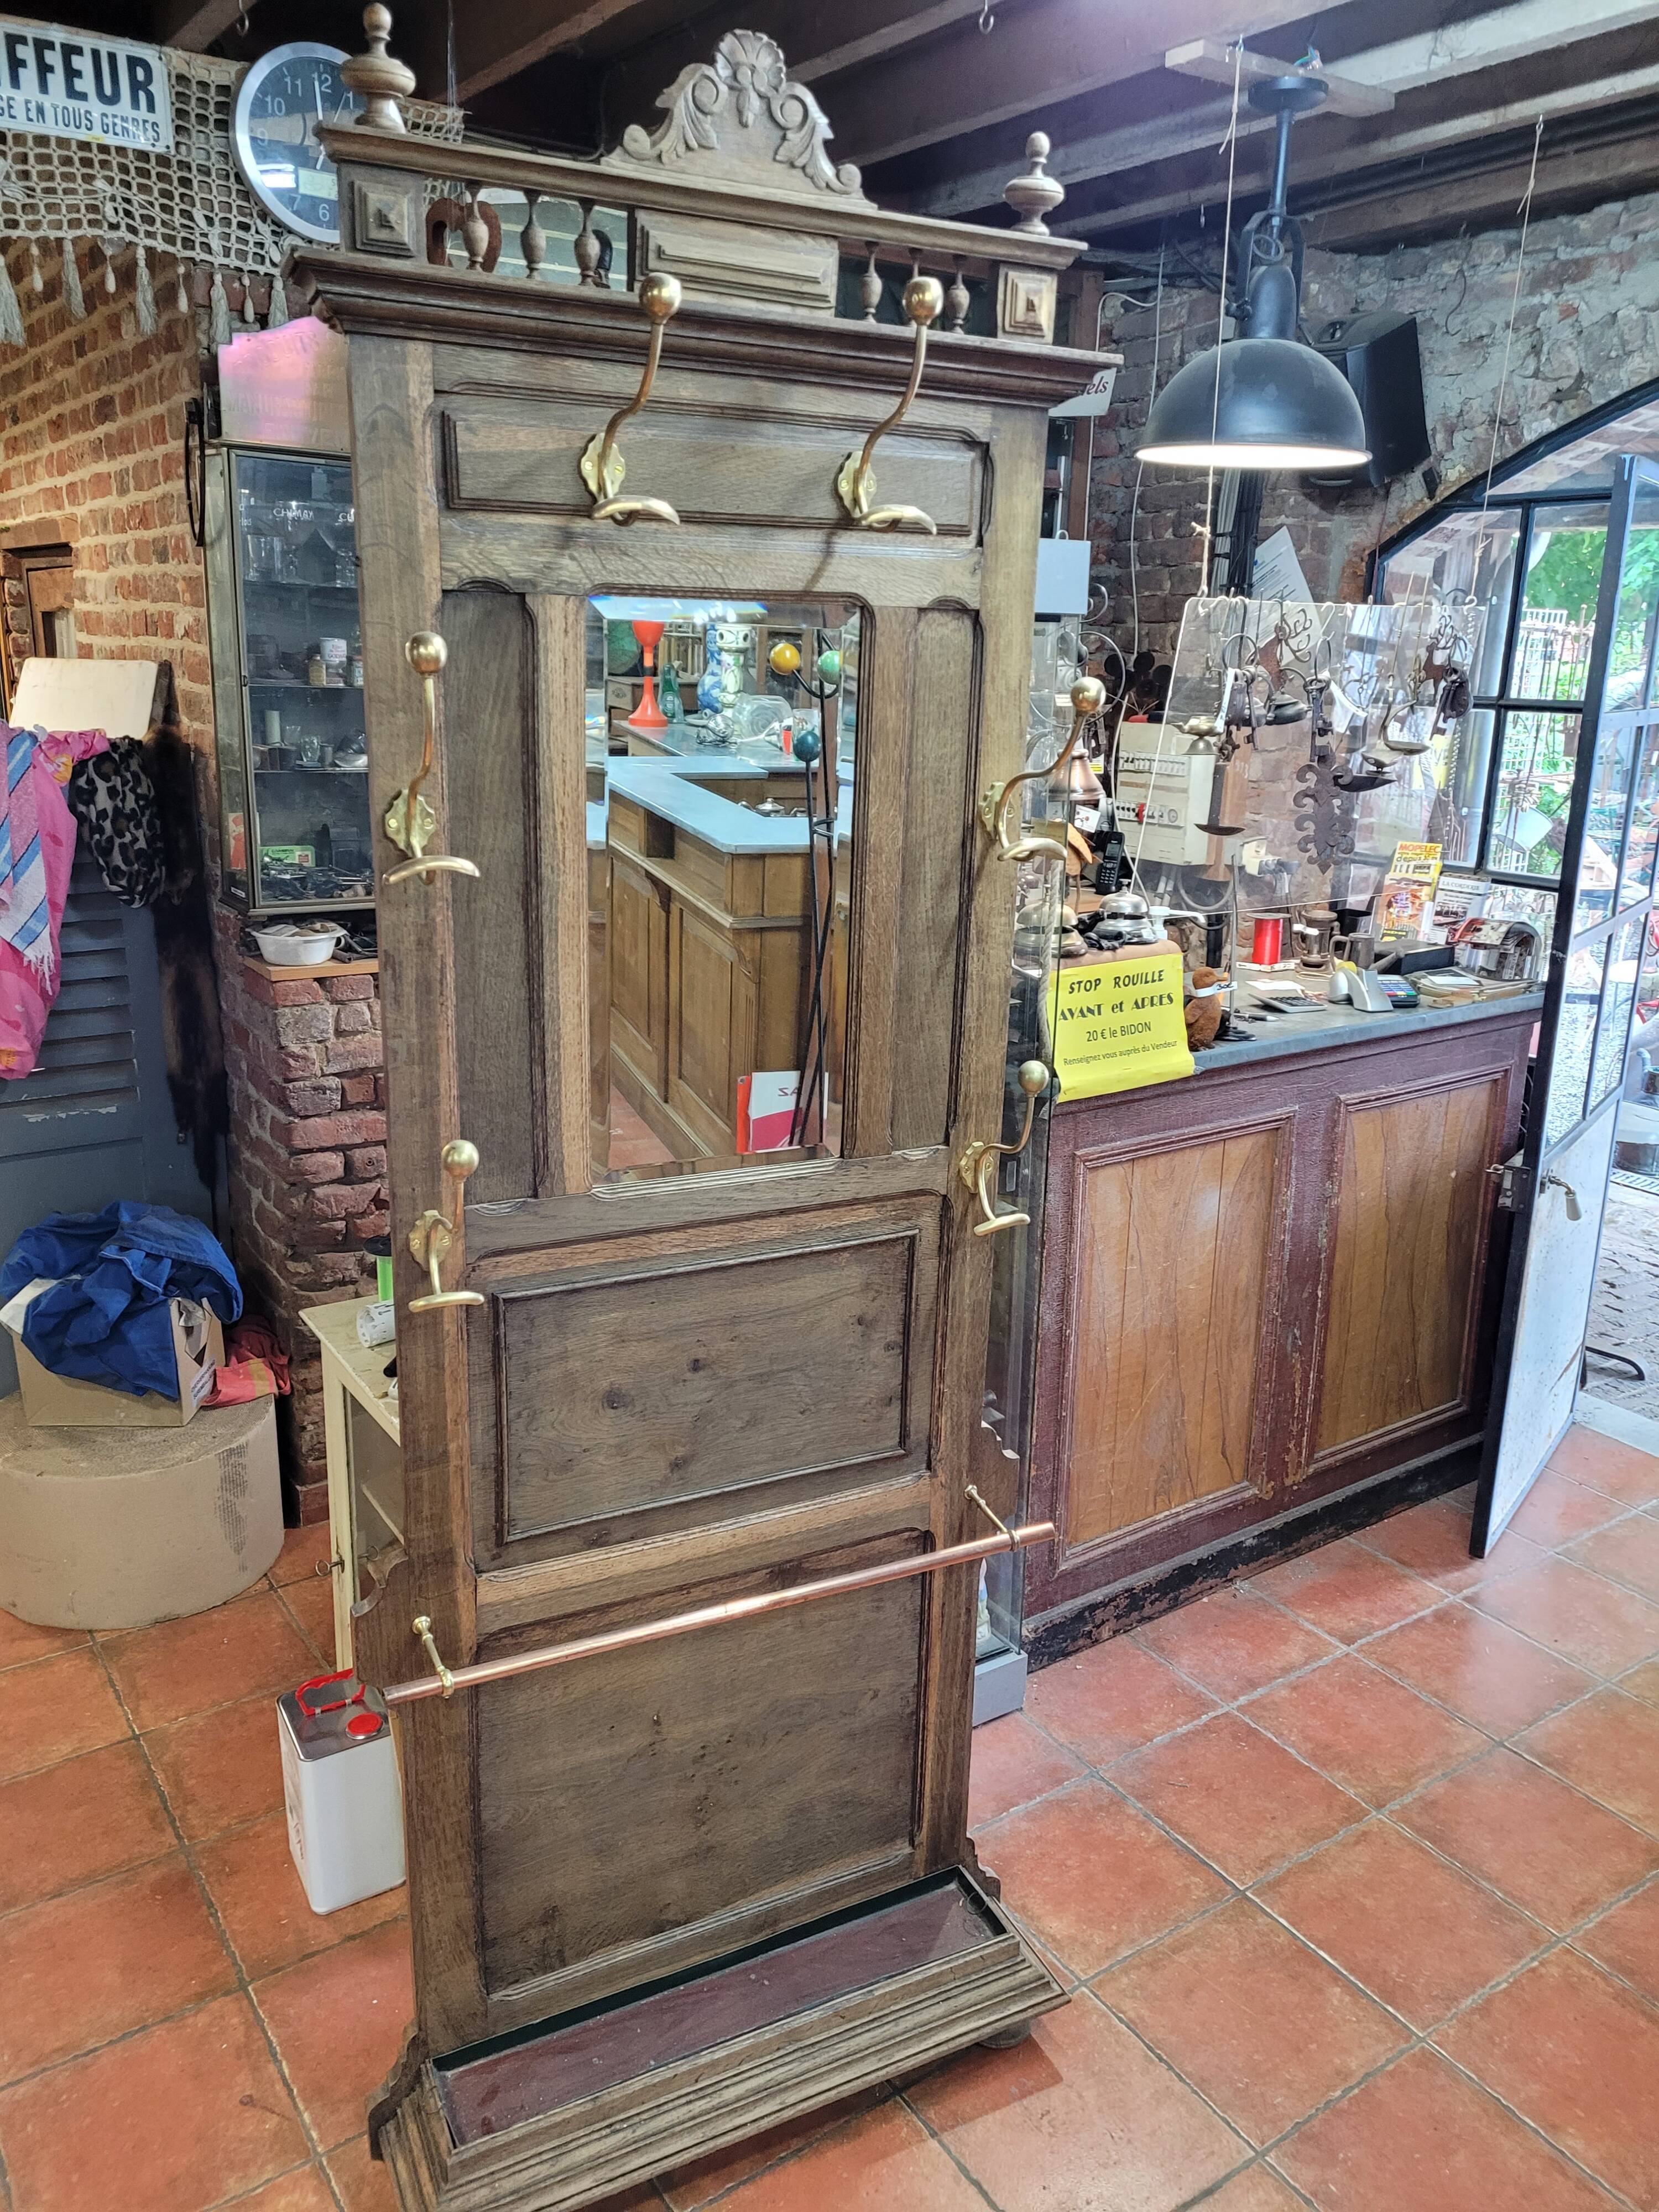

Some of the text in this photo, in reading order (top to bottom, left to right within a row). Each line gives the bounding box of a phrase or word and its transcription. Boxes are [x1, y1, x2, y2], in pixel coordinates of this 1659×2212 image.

[0, 31, 156, 114] FFEUR
[284, 76, 302, 97] 11
[264, 95, 286, 116] 10
[24, 98, 45, 124] EN
[50, 103, 93, 131] TOUS
[100, 112, 160, 142] GENRES
[257, 128, 268, 146] 9
[318, 203, 331, 222] 6
[1068, 969, 1165, 994] STOP ROUILLE
[1058, 992, 1174, 1021] AVANT et APRES
[1086, 1021, 1152, 1042] 20 € le BIDON
[1063, 1054, 1101, 1066] Renseignez
[1119, 1046, 1141, 1057] auprès
[1150, 1040, 1177, 1051] Vendeur
